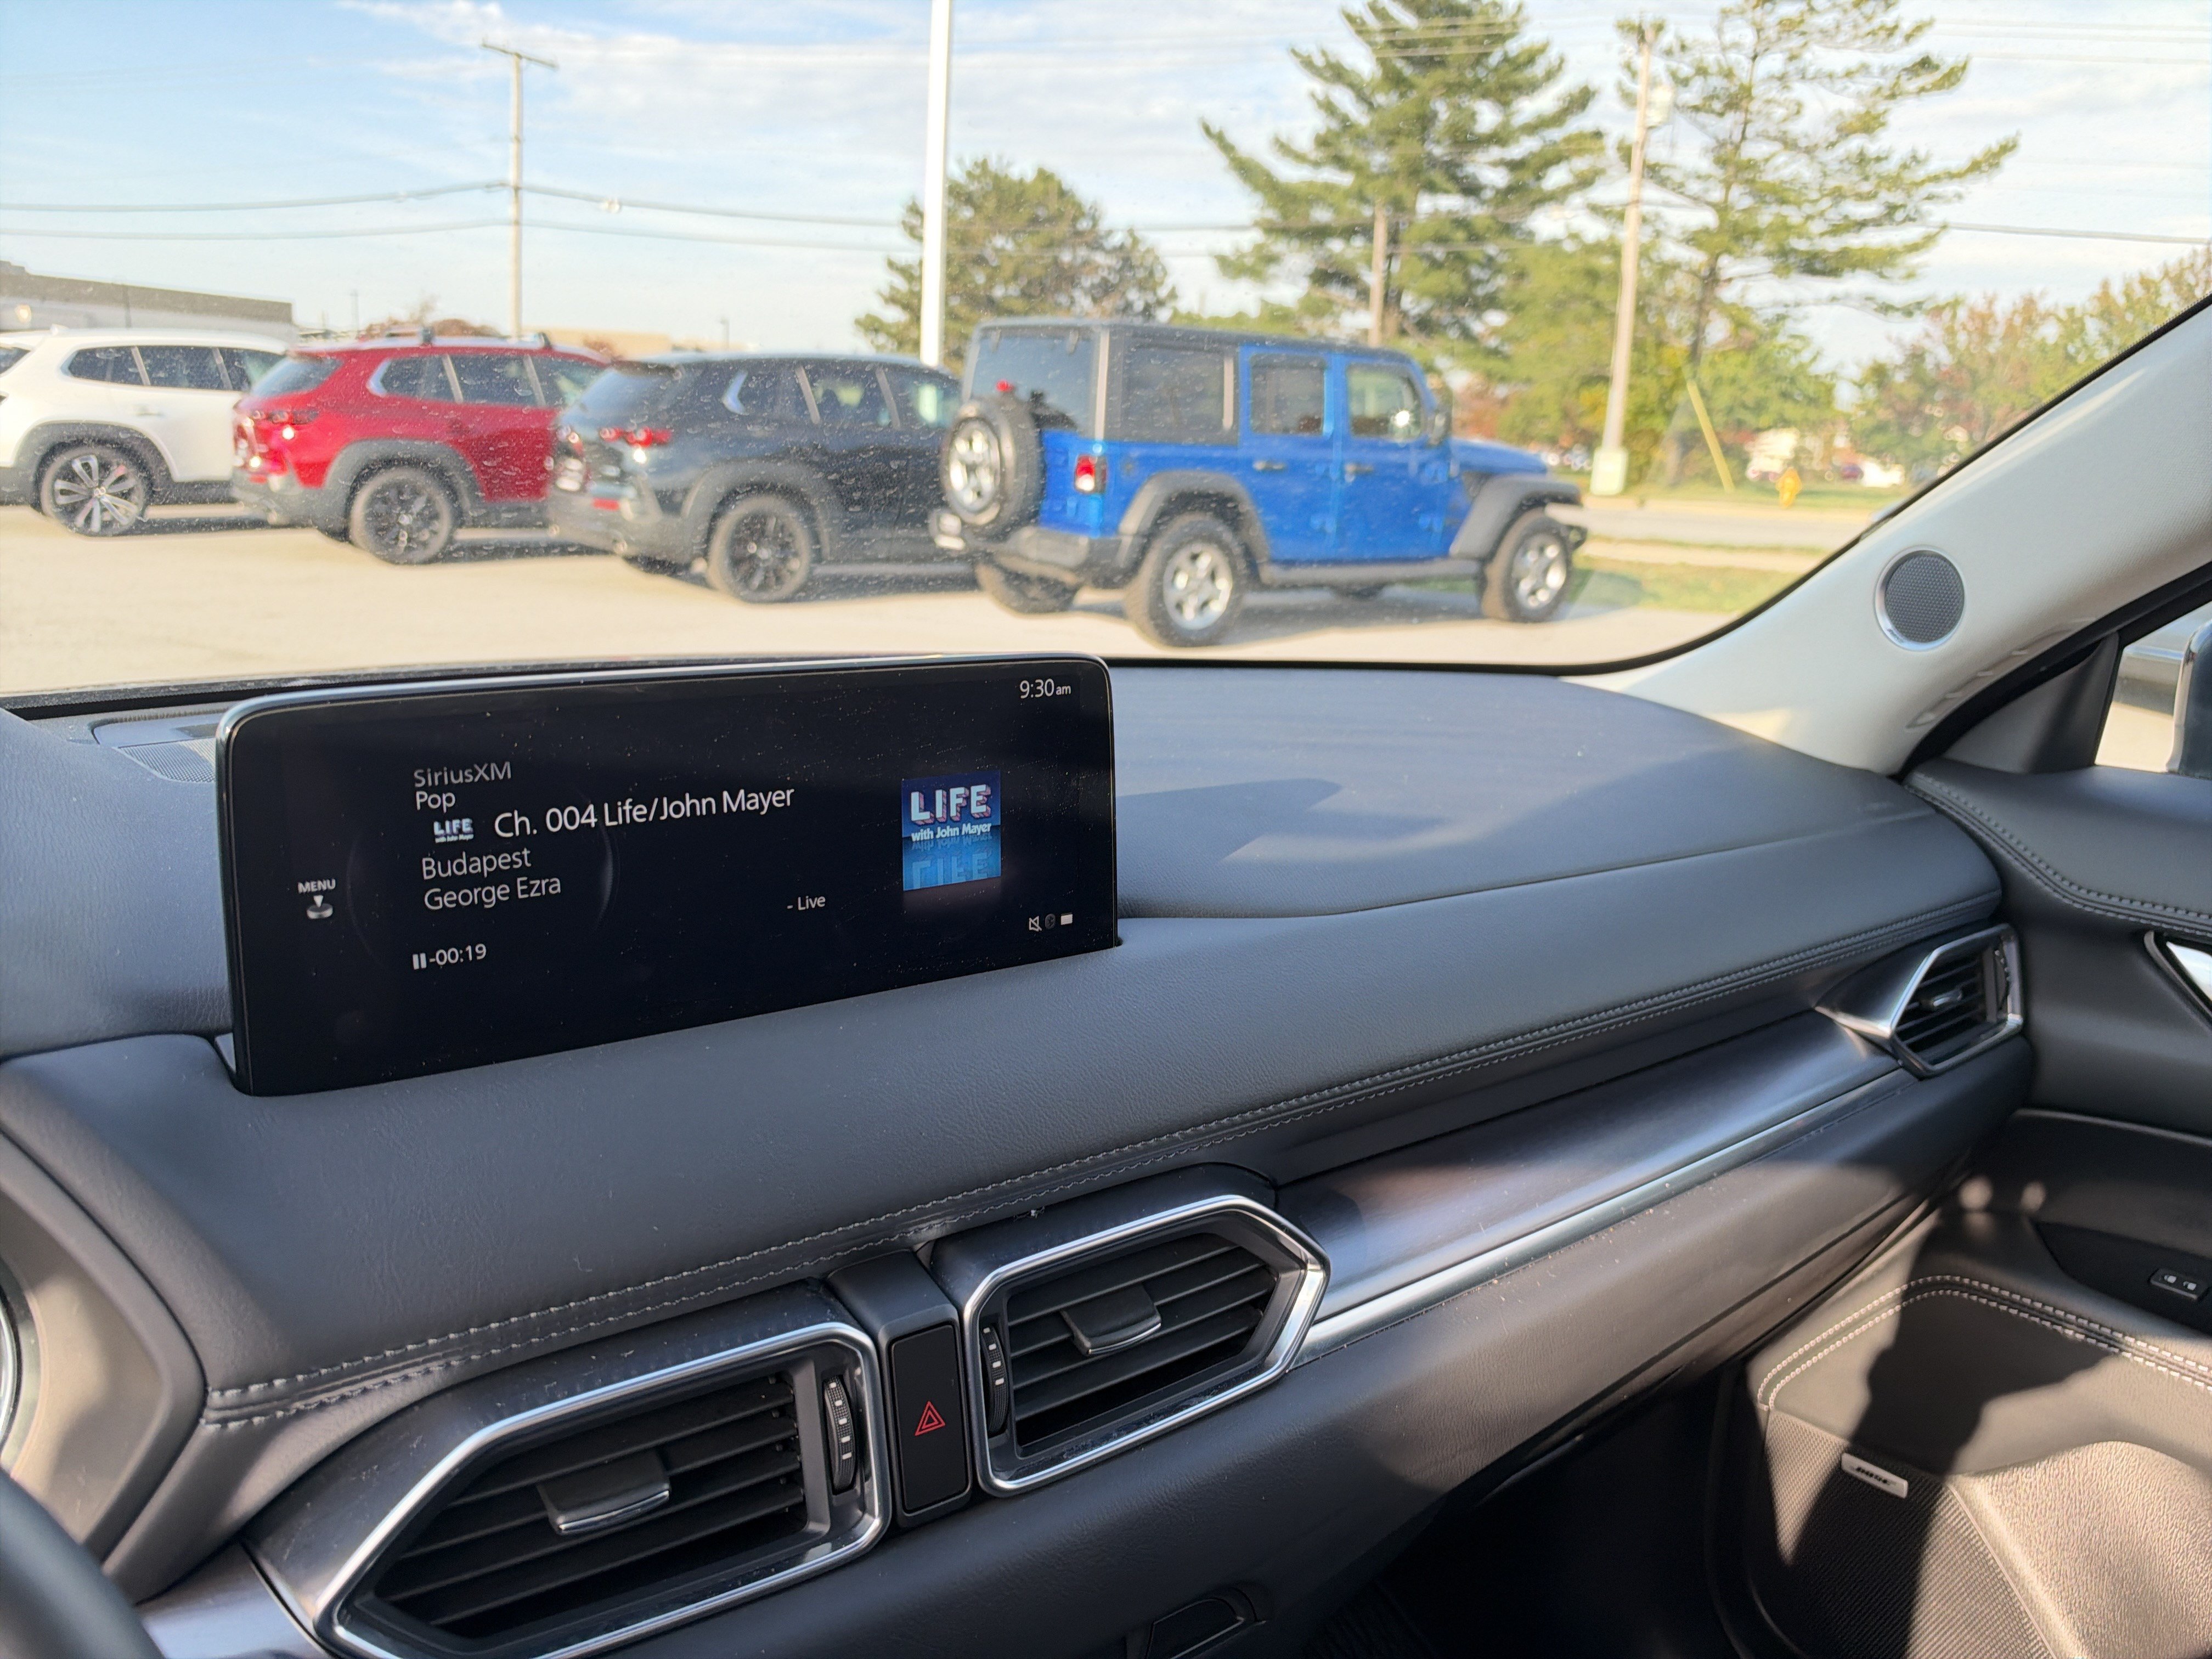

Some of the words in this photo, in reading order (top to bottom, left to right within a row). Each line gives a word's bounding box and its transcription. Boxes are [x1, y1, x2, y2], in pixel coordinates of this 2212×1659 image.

[414, 761, 511, 787] SiriusXM
[415, 791, 456, 813] Pop
[494, 809, 538, 837] Ch.
[546, 804, 598, 832] 004
[603, 793, 716, 826] Life/John
[723, 788, 794, 815] Mayer
[911, 784, 991, 825] LIFE
[433, 818, 473, 836] LIFE
[911, 827, 934, 842] with
[936, 825, 960, 839] John
[961, 822, 992, 836] Mayer
[422, 848, 532, 879] Budapest
[297, 878, 336, 894] MENU
[424, 884, 510, 910] George
[516, 877, 561, 899] Ezra
[798, 895, 826, 911] Live
[429, 943, 487, 966] -00:19
